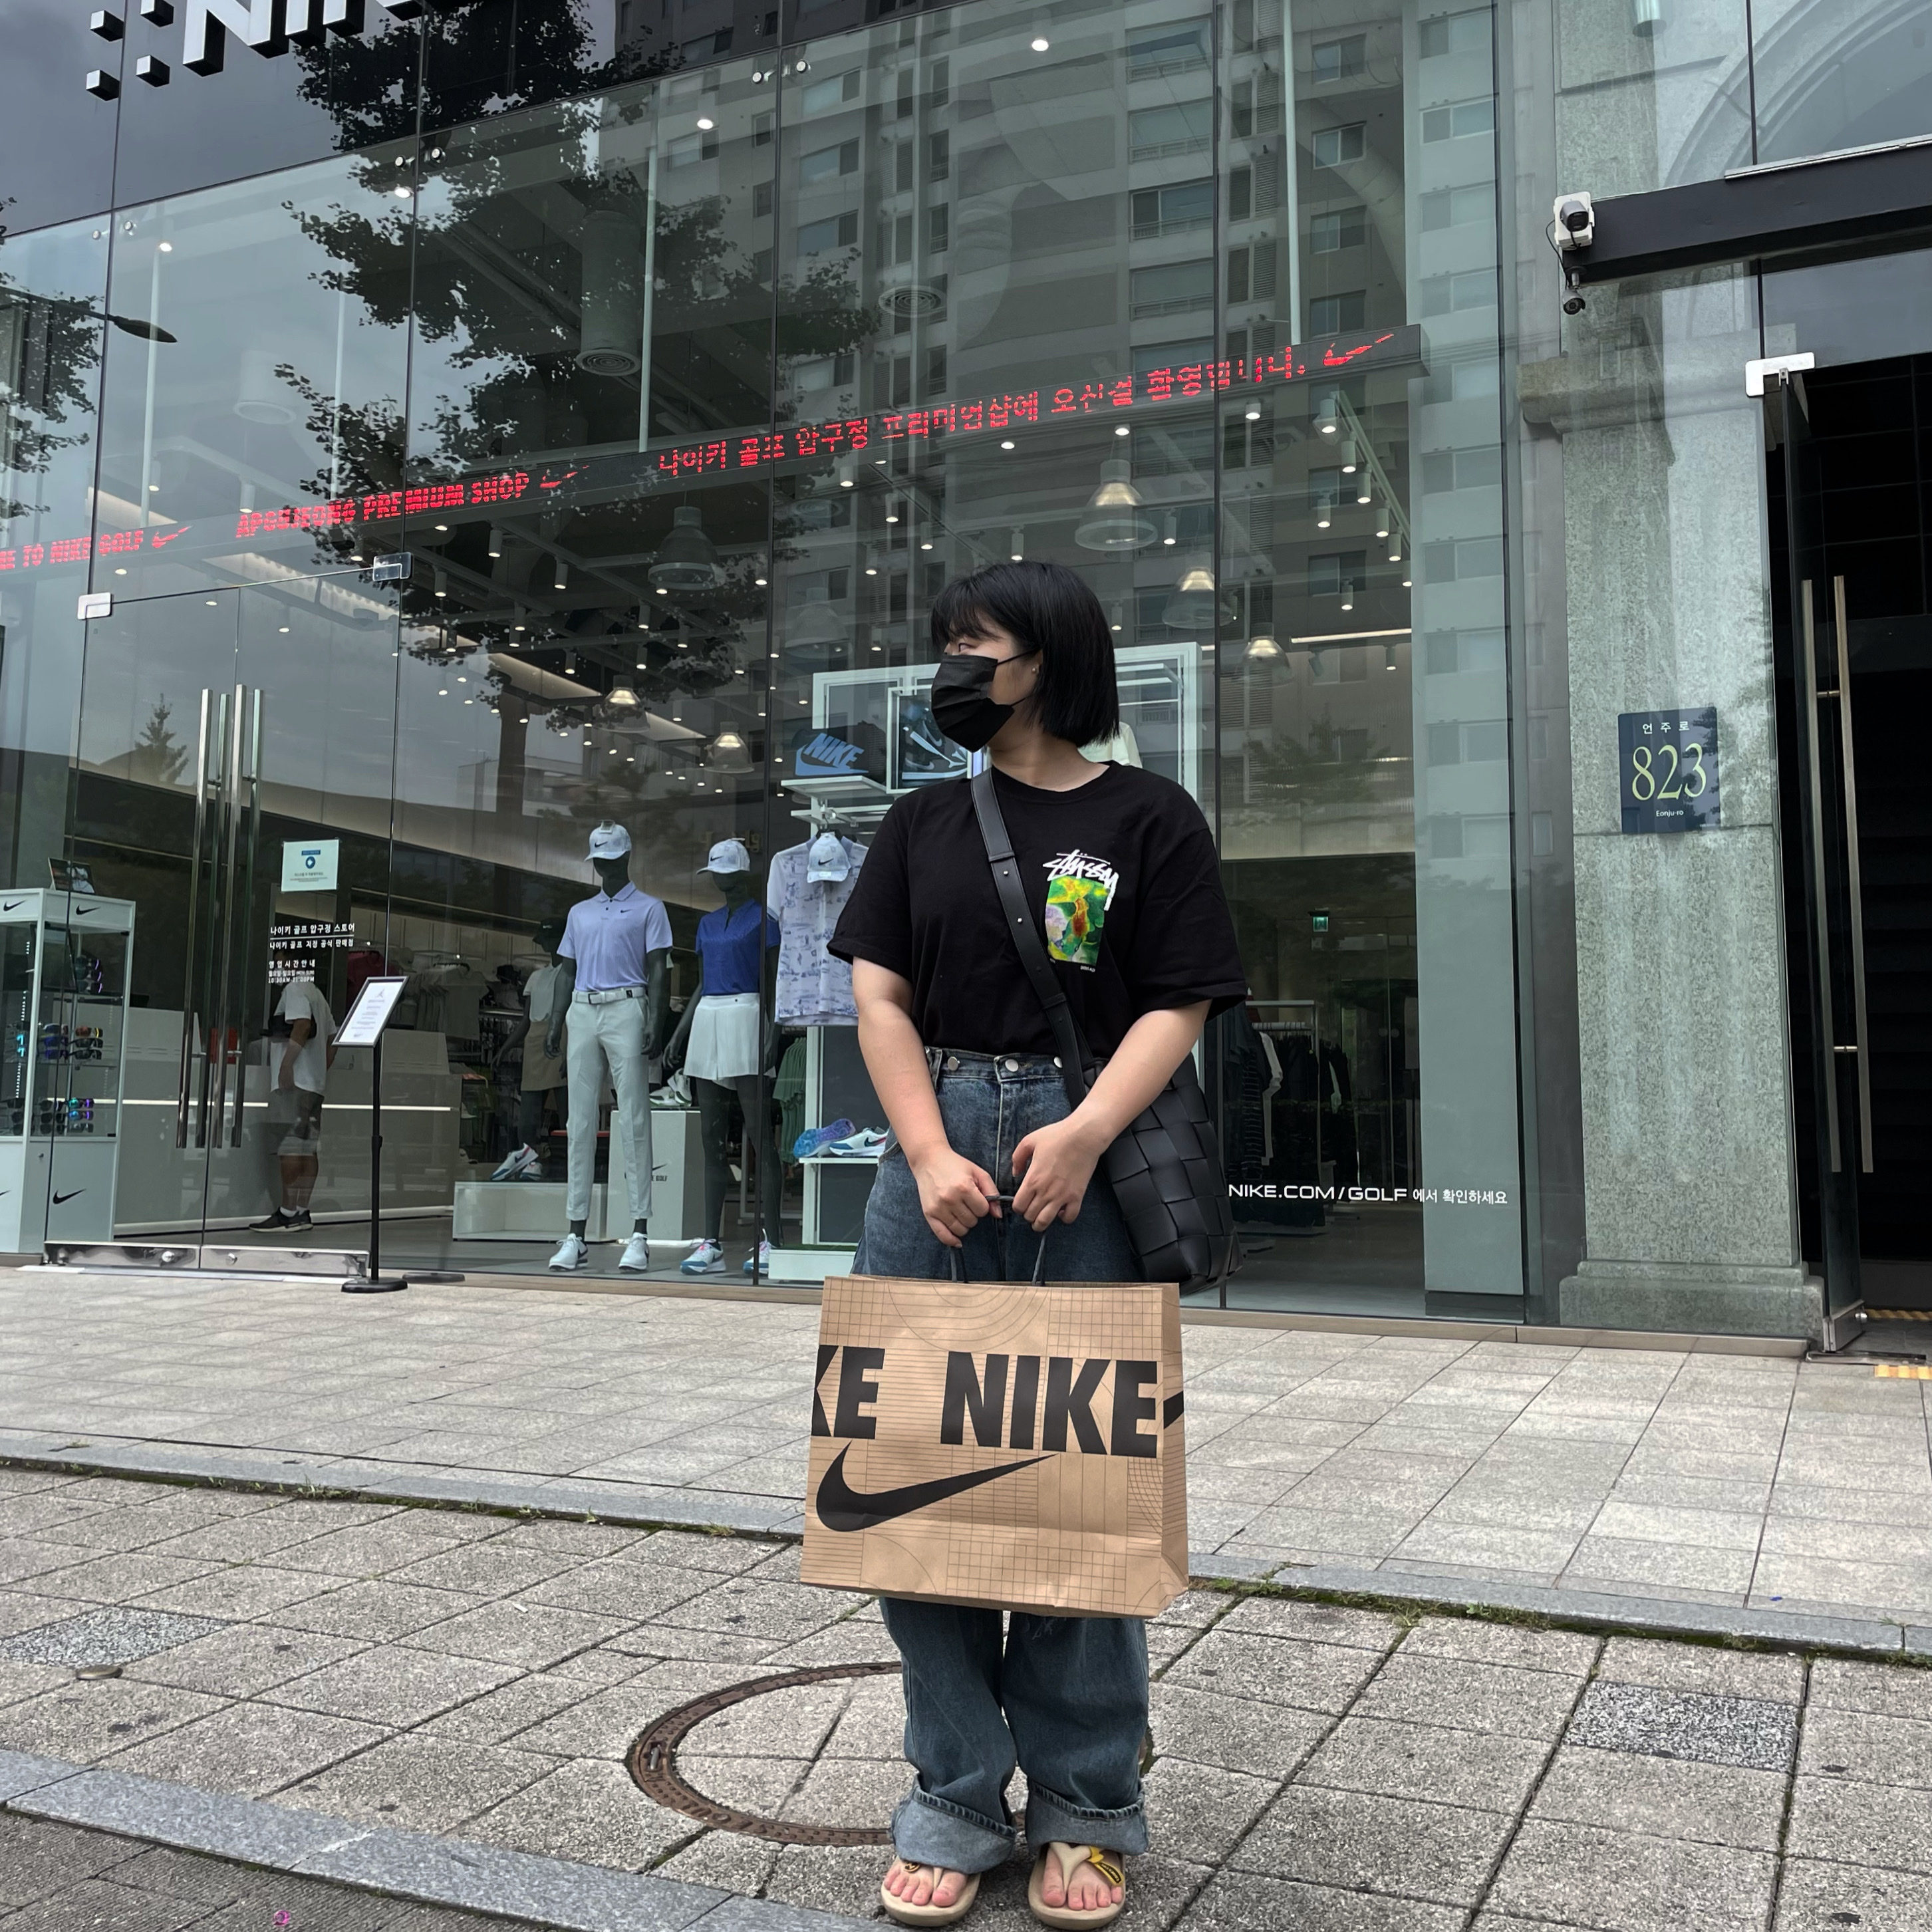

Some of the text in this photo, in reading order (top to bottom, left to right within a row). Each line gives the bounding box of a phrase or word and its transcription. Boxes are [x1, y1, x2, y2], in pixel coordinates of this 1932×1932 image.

[659, 440, 727, 476] 나이키
[738, 434, 785, 467] 골프
[795, 418, 868, 456] 압구정
[362, 483, 465, 521] PREMIUM
[471, 472, 529, 503] SHOP
[23, 544, 44, 567] TO
[50, 537, 91, 563] NIKE
[98, 530, 144, 556] GOLF
[803, 733, 864, 769] NIKE
[1632, 743, 1707, 801] 823
[269, 938, 354, 950] 나이키 골프 지정 공식 판매점
[271, 923, 355, 935] 나이키 골프 압구정 스토어
[1228, 1184, 1508, 1204] NIKE.COM/GOLF 에서 확인하세요
[940, 1351, 1157, 1458] NIKE
